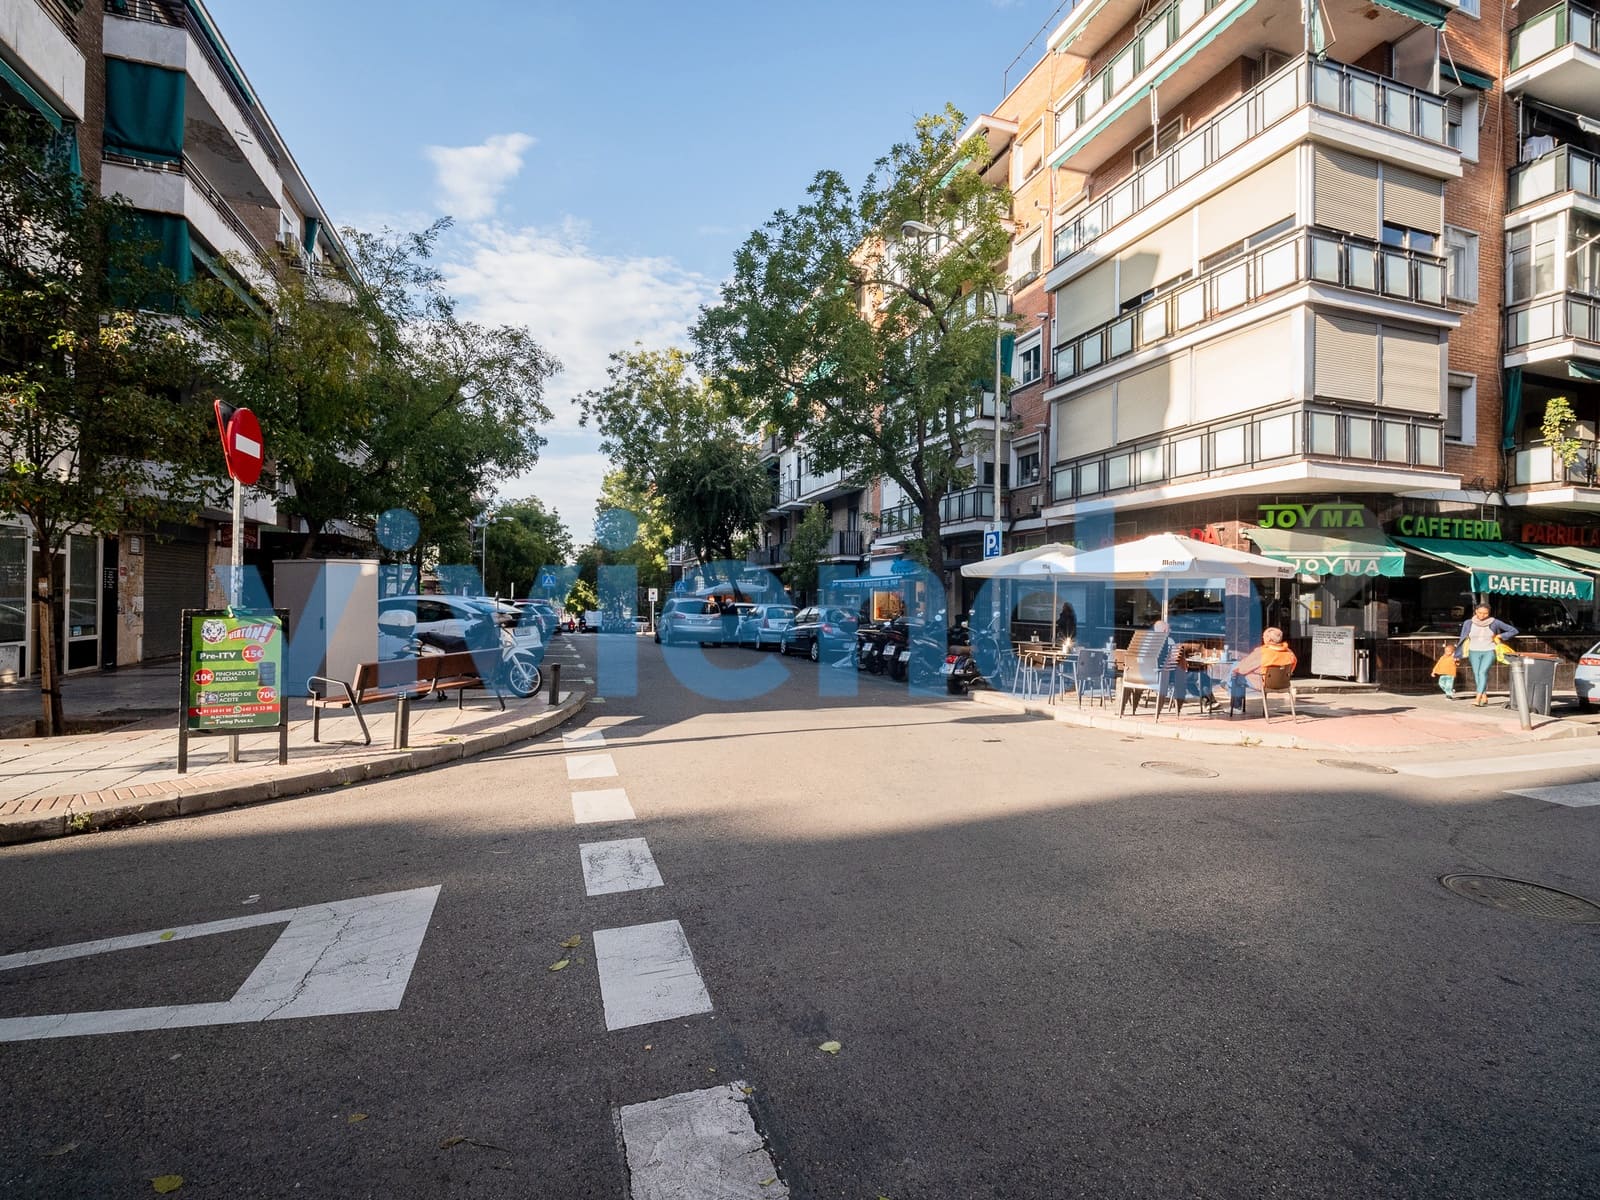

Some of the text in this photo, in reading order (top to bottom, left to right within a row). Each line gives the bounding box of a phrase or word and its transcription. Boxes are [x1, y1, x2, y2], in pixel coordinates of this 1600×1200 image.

[1258, 503, 1365, 529] JOYMA
[1399, 515, 1503, 540] CAFETERIA
[986, 535, 997, 555] P
[1287, 556, 1380, 573] JOYMA
[1488, 575, 1577, 596] CAFETERIA
[200, 651, 236, 660] Pre-ITV
[244, 650, 263, 658] 15€
[259, 691, 276, 699] 70€
